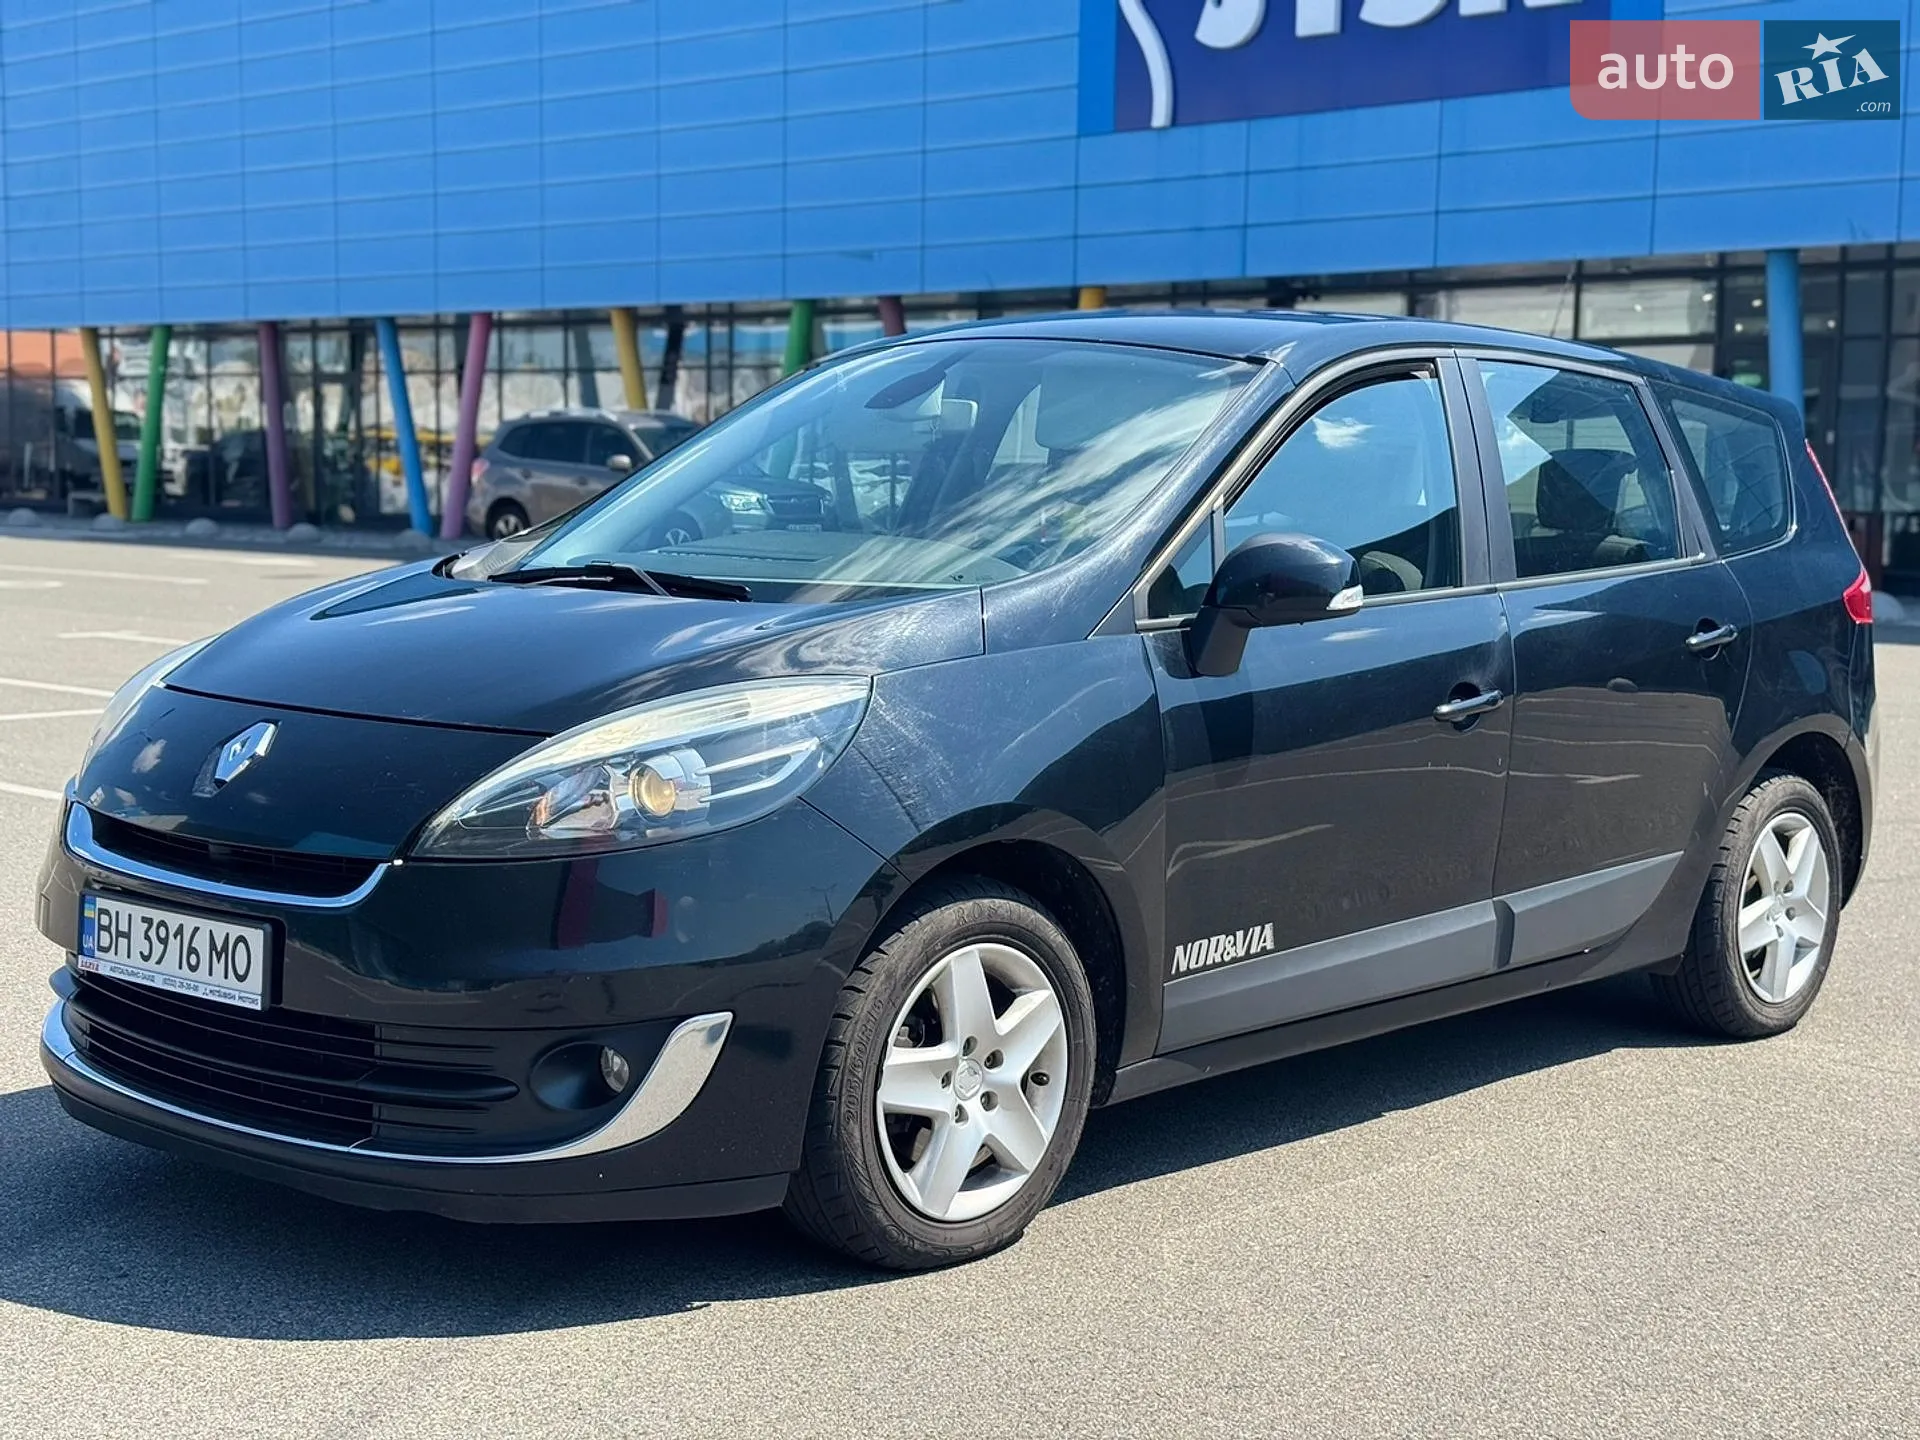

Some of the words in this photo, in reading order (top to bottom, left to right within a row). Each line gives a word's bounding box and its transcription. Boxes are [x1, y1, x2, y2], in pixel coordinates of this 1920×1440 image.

[83, 934, 95, 948] UA
[97, 908, 132, 959] BH
[139, 915, 201, 973] 3916
[208, 929, 252, 983] MO
[1171, 922, 1275, 975] NOR&VIA
